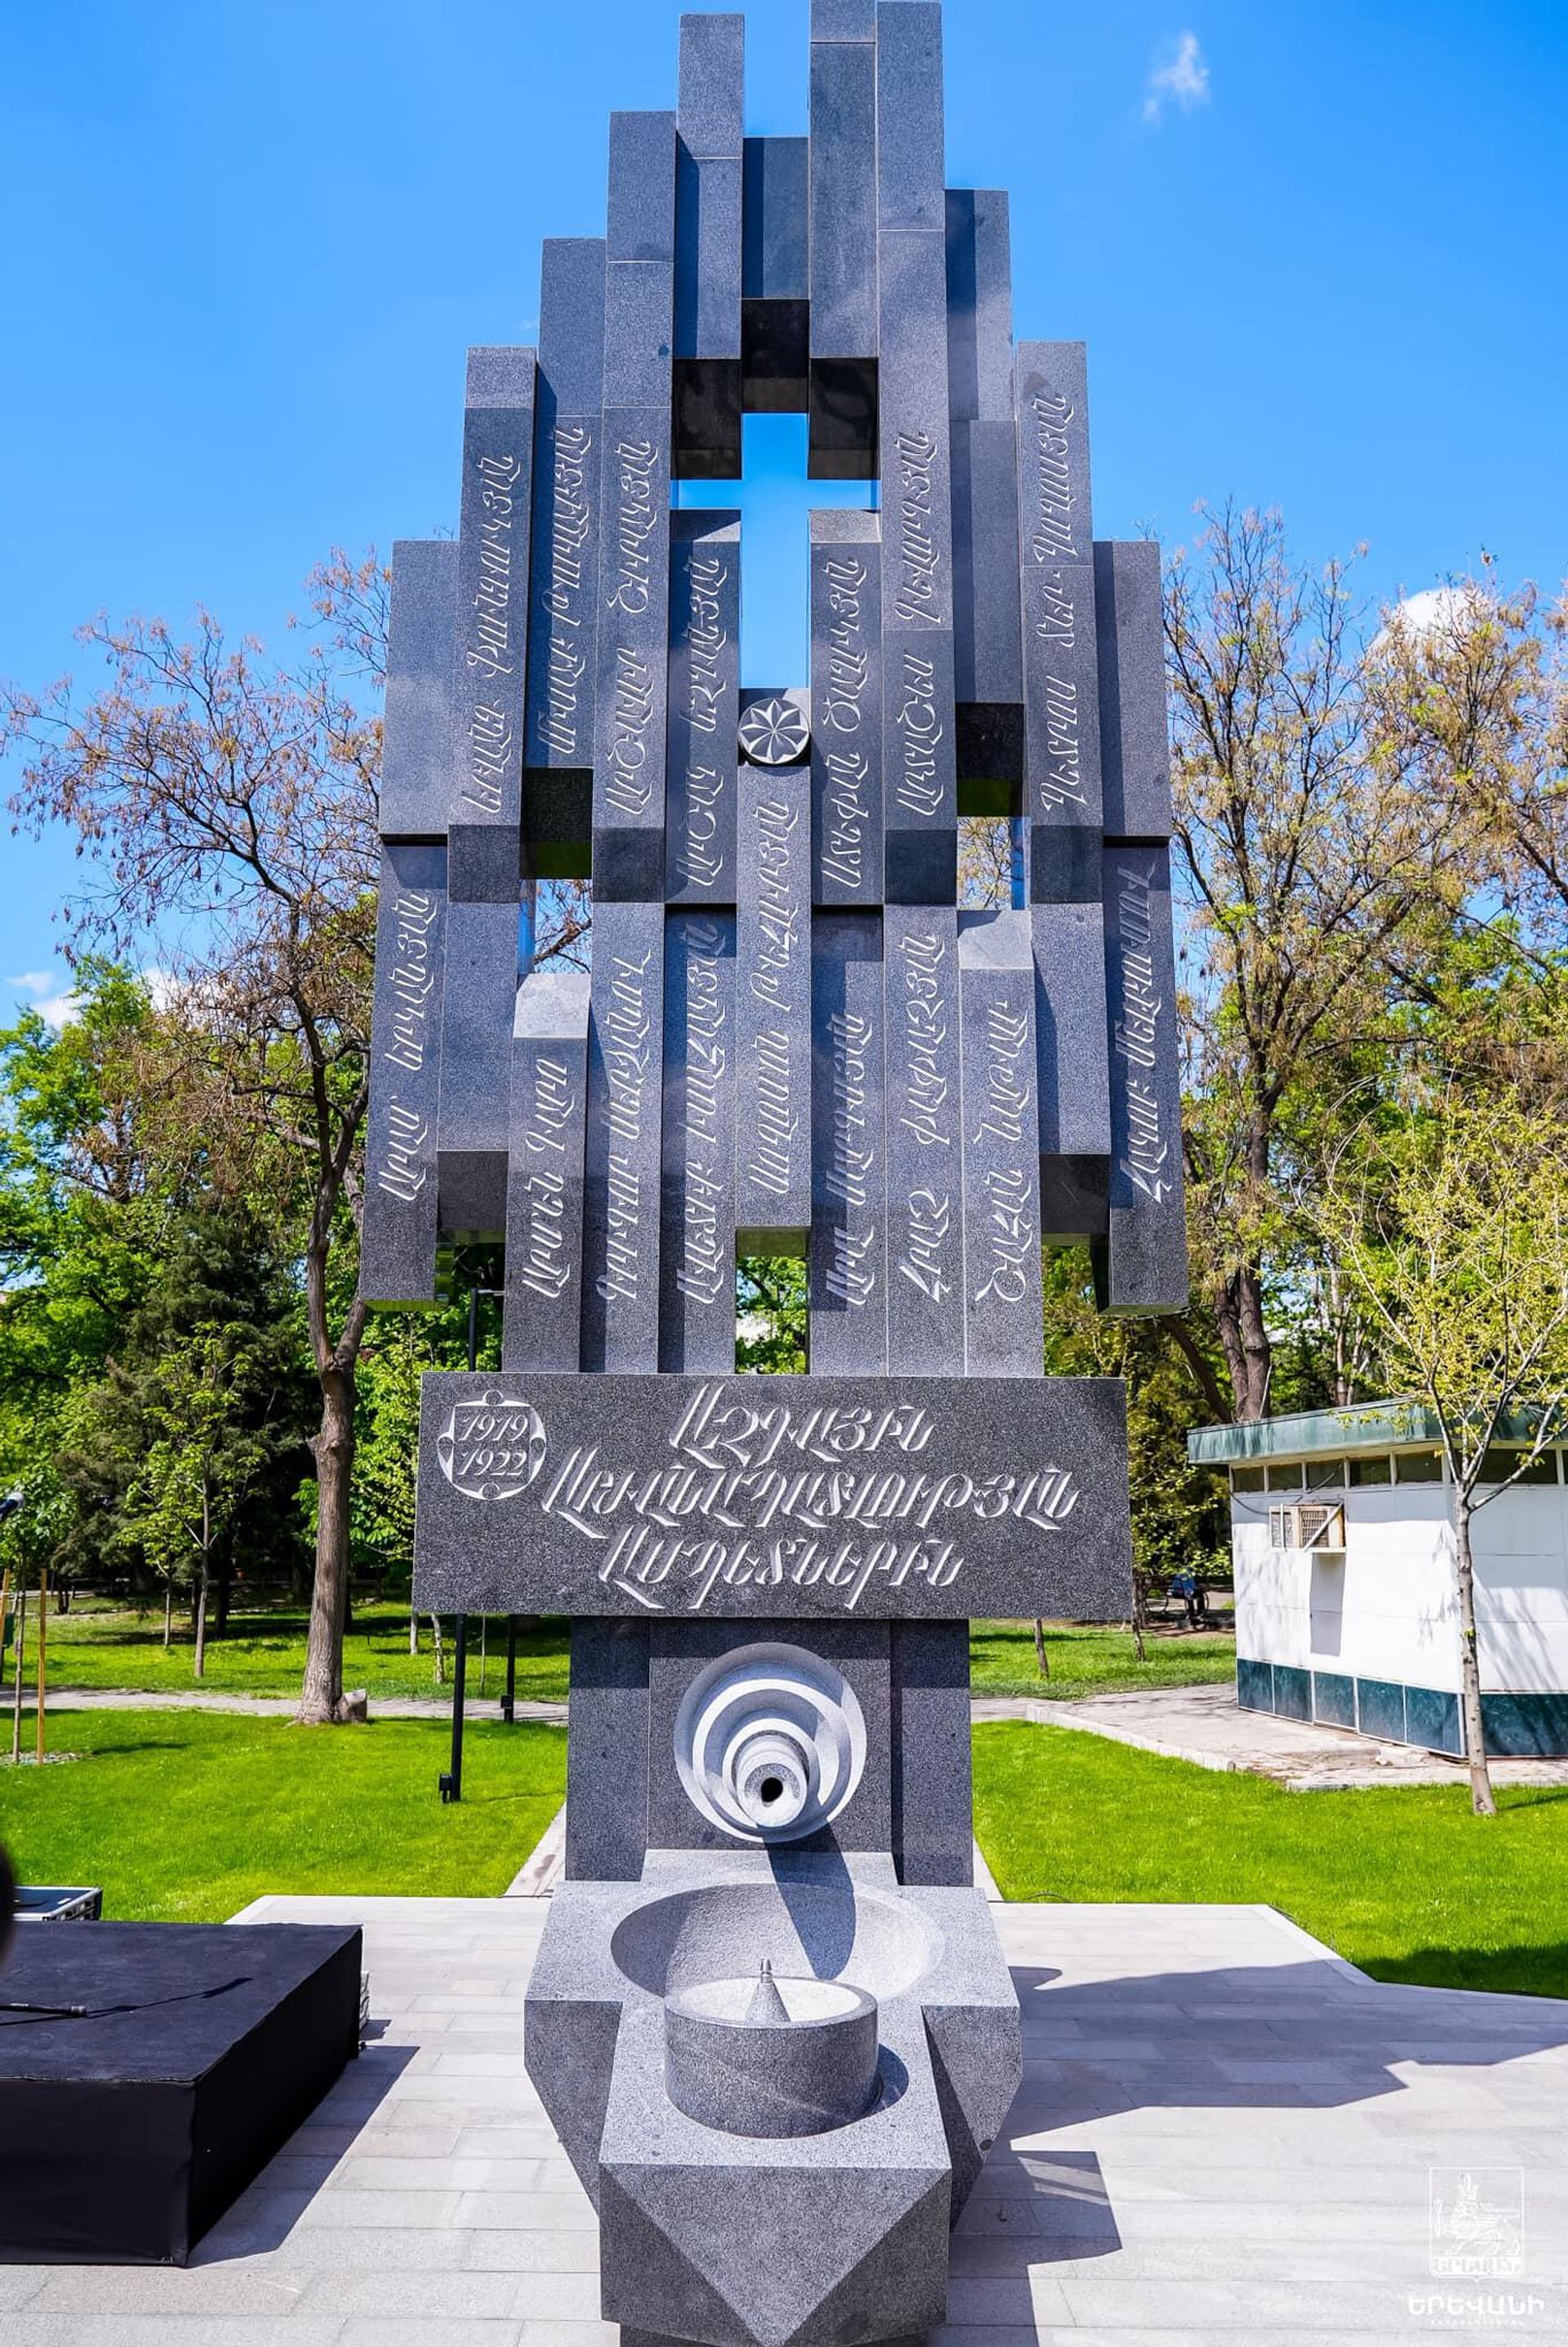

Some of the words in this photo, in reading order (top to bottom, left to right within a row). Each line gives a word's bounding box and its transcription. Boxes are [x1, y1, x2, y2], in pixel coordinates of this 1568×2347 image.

[607, 441, 658, 614] ՇԻՐԱԿՅԱՆ
[605, 645, 653, 816] ԱՐՇԱՎԻՐ
[1039, 675, 1089, 811] ՊԵՏՐՈՍ
[675, 765, 724, 887] ԱՐՇԱԿ
[822, 751, 869, 889] ՍՏԵՓԱՆ
[378, 1096, 428, 1201] ԱՐԱՄ
[749, 1029, 798, 1195] ՍՈՂՈՄՈՆ
[522, 1172, 570, 1298] ԱՐՄԵՆ
[826, 1227, 875, 1306] ԱՐԱ
[974, 1169, 1032, 1303] ՇԱՀԱՆ
[457, 1414, 528, 1442] 1919
[457, 1446, 528, 1476] 1922
